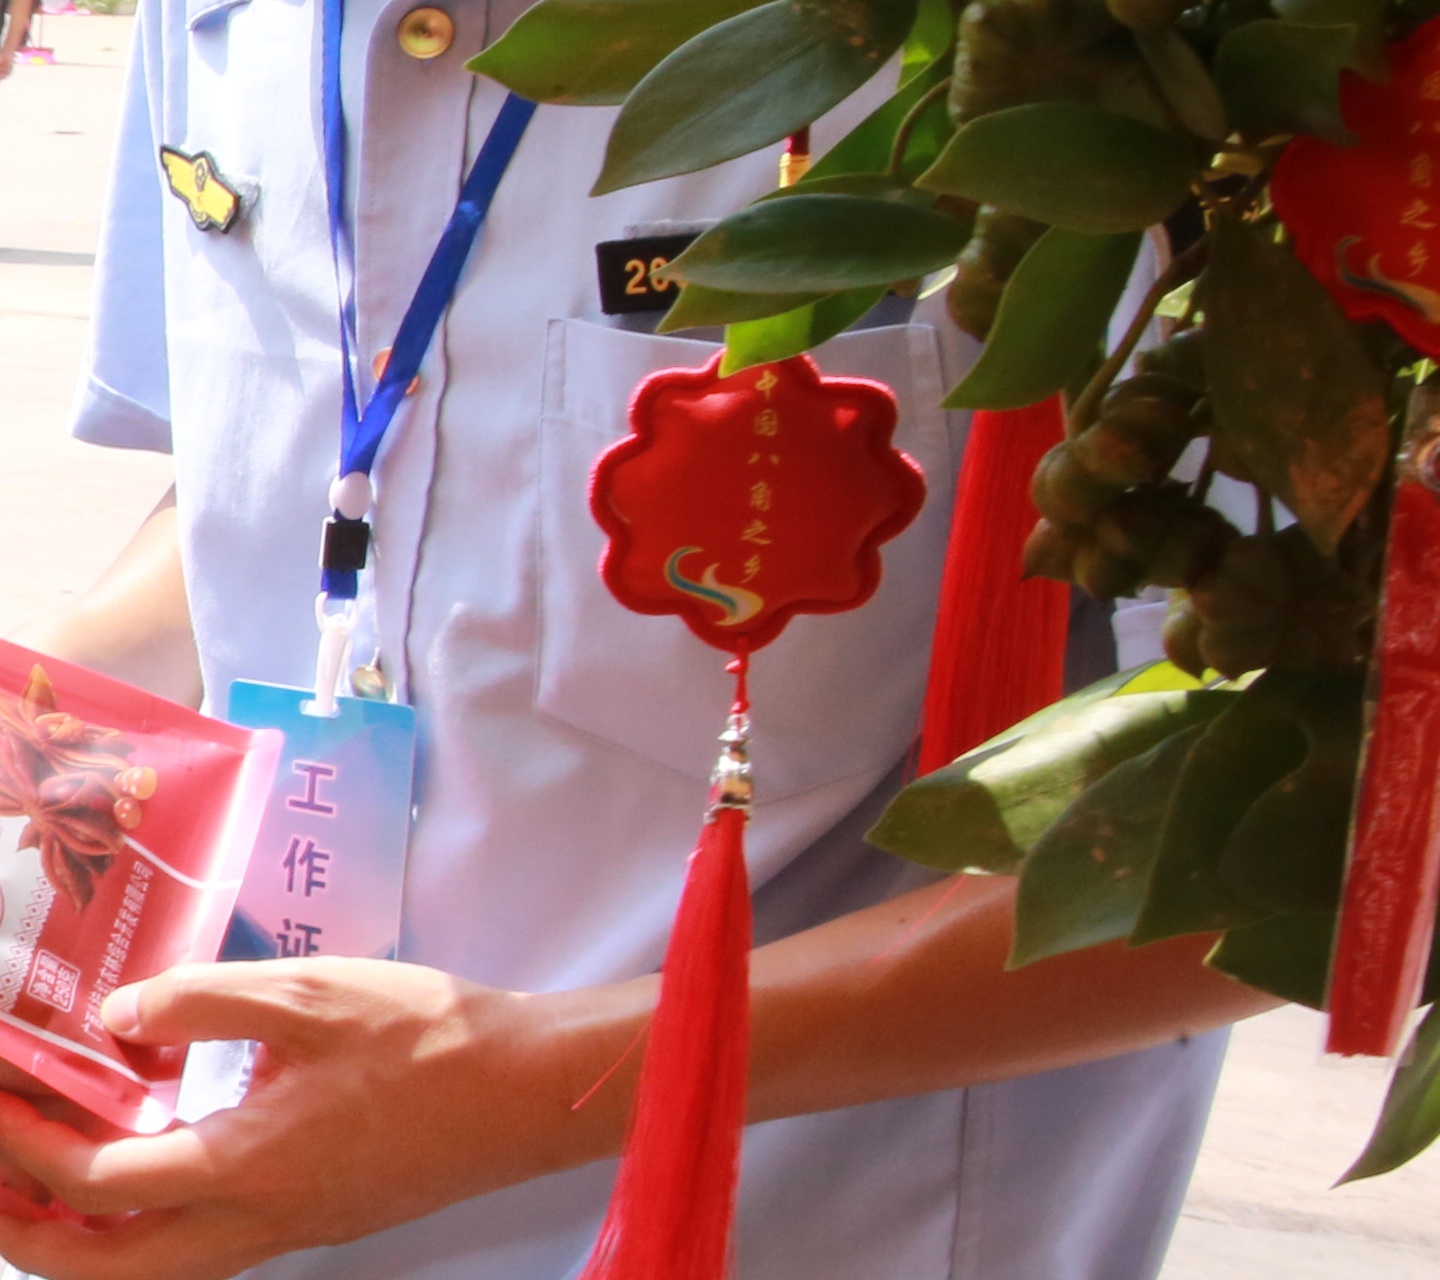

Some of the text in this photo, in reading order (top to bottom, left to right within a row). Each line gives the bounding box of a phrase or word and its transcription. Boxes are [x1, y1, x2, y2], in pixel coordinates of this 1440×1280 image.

[742, 367, 782, 584] 中国八角之乡
[277, 760, 337, 957] 工作证
